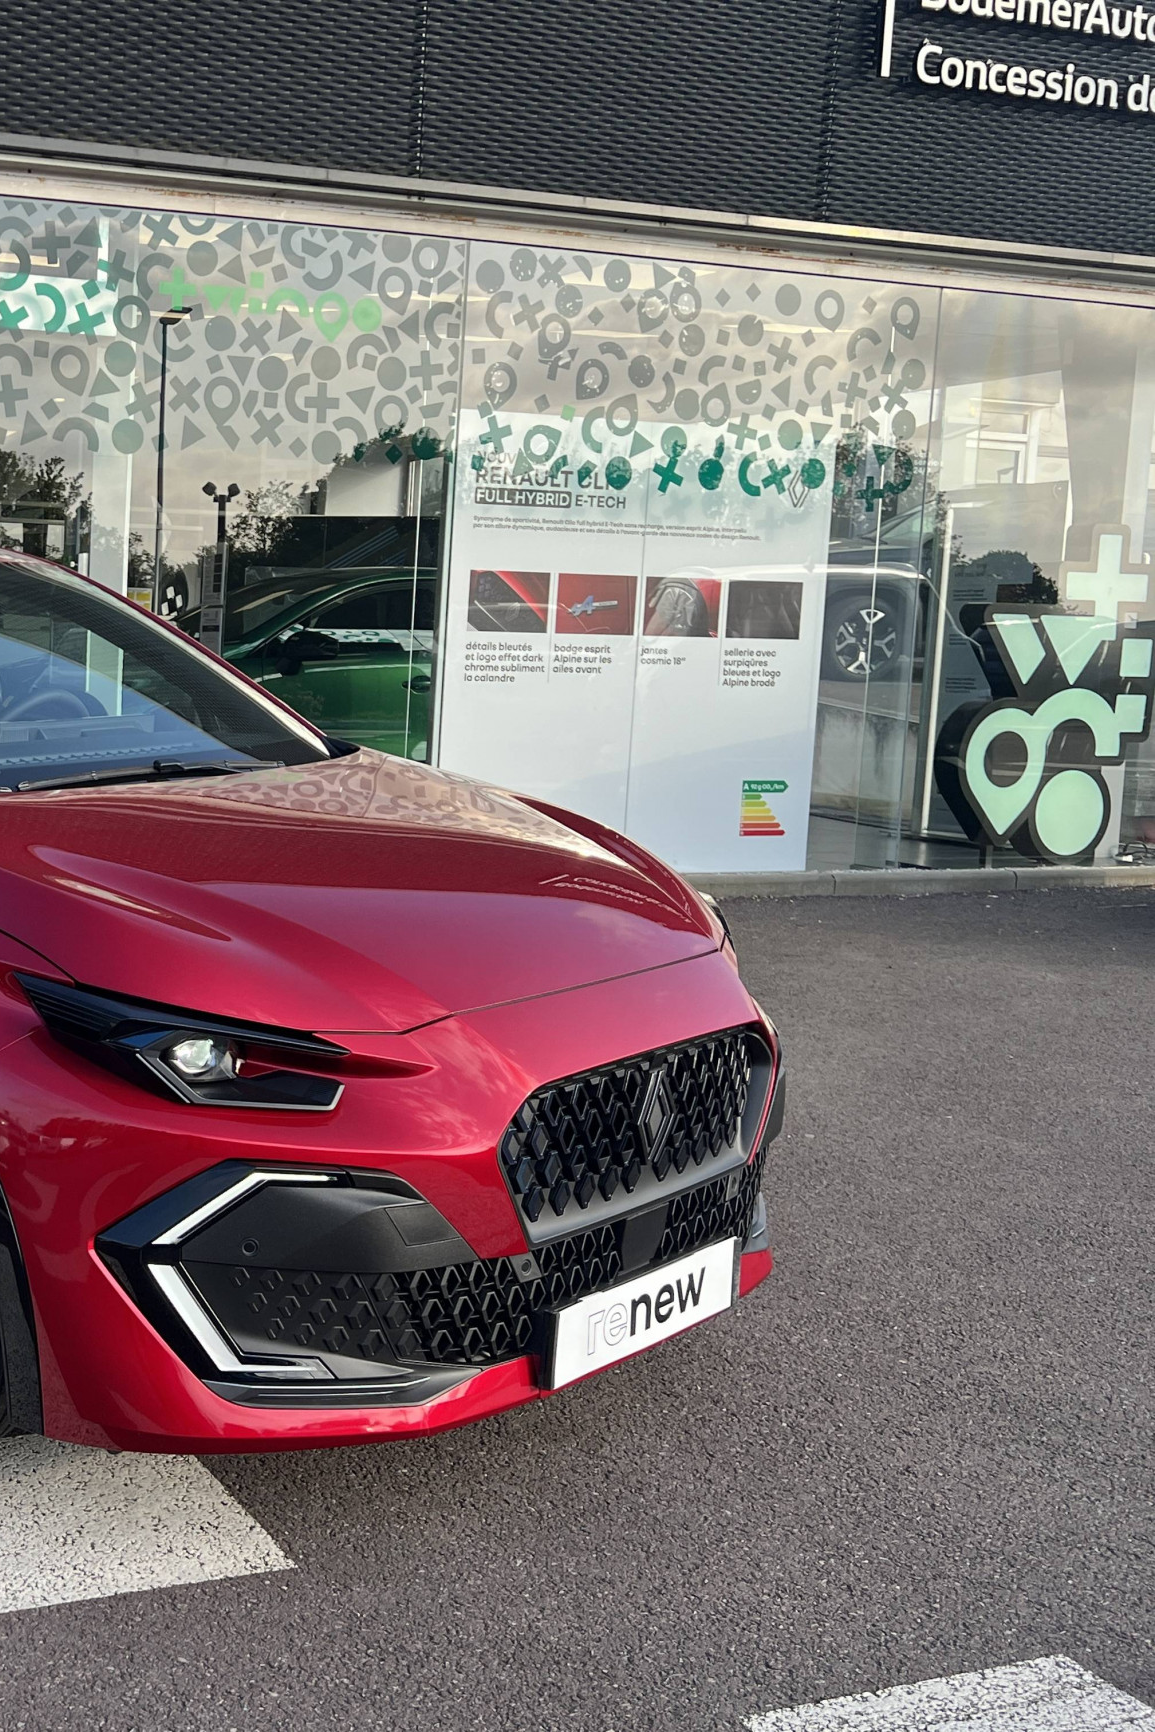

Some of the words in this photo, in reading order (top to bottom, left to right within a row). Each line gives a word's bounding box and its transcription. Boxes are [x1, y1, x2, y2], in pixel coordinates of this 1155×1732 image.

[916, 43, 1119, 110] Concession
[1127, 74, 1155, 113] d
[476, 489, 512, 504] FULL
[515, 491, 571, 507] HYBRID
[575, 494, 626, 509] E-TECH
[466, 642, 497, 652] détails
[498, 642, 532, 652] bleutés
[554, 644, 583, 655] badge
[584, 644, 611, 655] esprit
[640, 646, 668, 656] jantes
[465, 653, 474, 661] et
[476, 653, 497, 663] logo
[498, 653, 521, 662] effet
[522, 654, 543, 662] dark
[724, 649, 754, 657] sellerie
[756, 649, 776, 657] avec
[553, 654, 582, 664] Alpine
[599, 655, 612, 664] les
[640, 656, 672, 665] cosmic
[723, 657, 768, 668] surpiqûres
[464, 663, 499, 672] chrome
[500, 664, 545, 673] subliment
[553, 665, 573, 673] ailes
[575, 666, 601, 674] avant
[464, 673, 473, 682] la
[474, 673, 515, 682] calandre
[723, 669, 750, 677] bleues
[752, 669, 760, 677] et
[762, 669, 781, 679] logo
[722, 678, 749, 687] Alpine
[750, 677, 775, 687] brodé
[587, 1266, 706, 1356] renew
